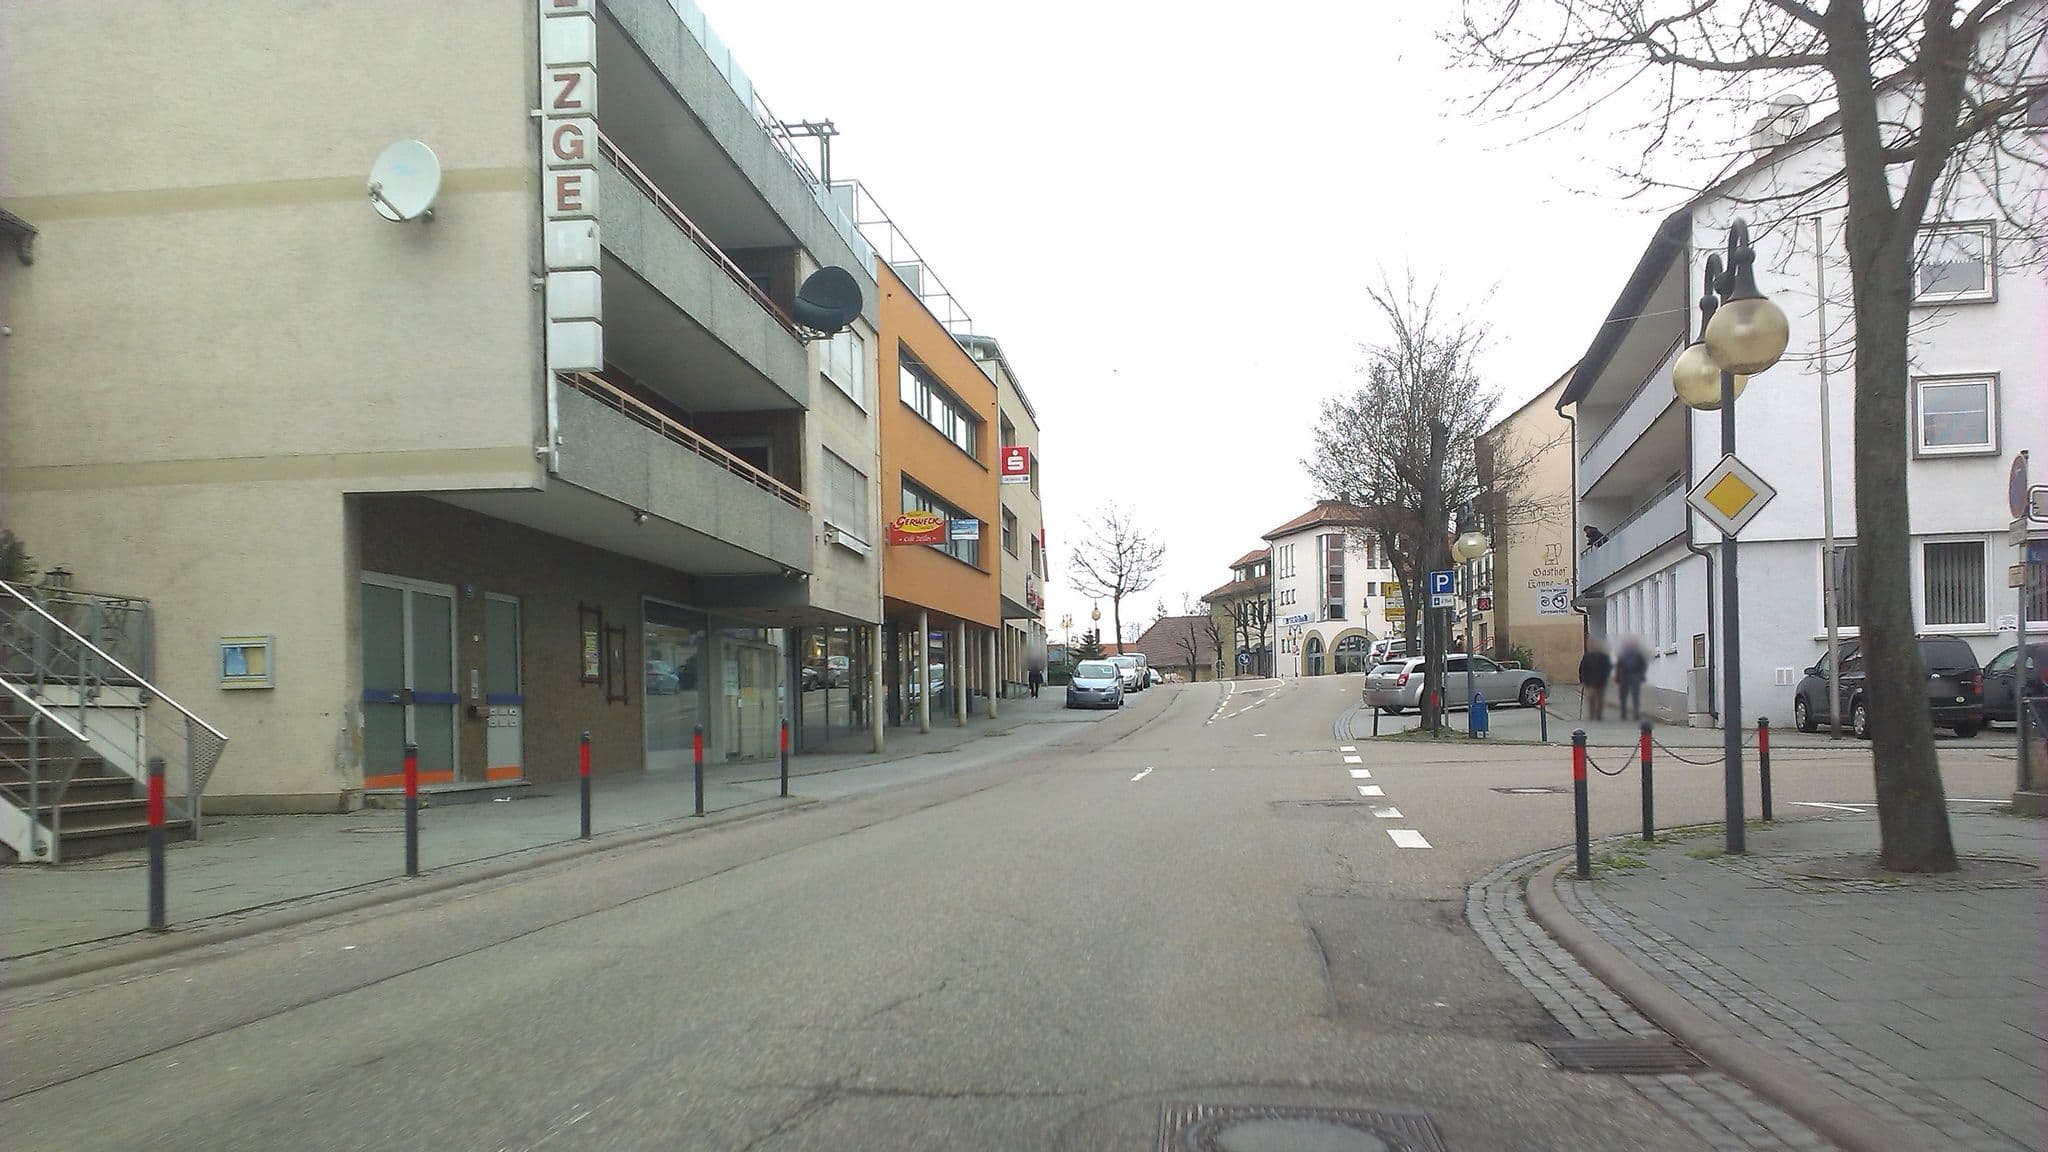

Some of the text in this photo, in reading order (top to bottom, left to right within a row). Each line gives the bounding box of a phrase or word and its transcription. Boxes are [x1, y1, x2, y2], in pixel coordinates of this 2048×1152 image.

[551, 0, 585, 211] ZGE
[893, 515, 943, 529] GERWECK
[1532, 566, 1567, 577] Gasthof
[1436, 574, 1449, 592] P
